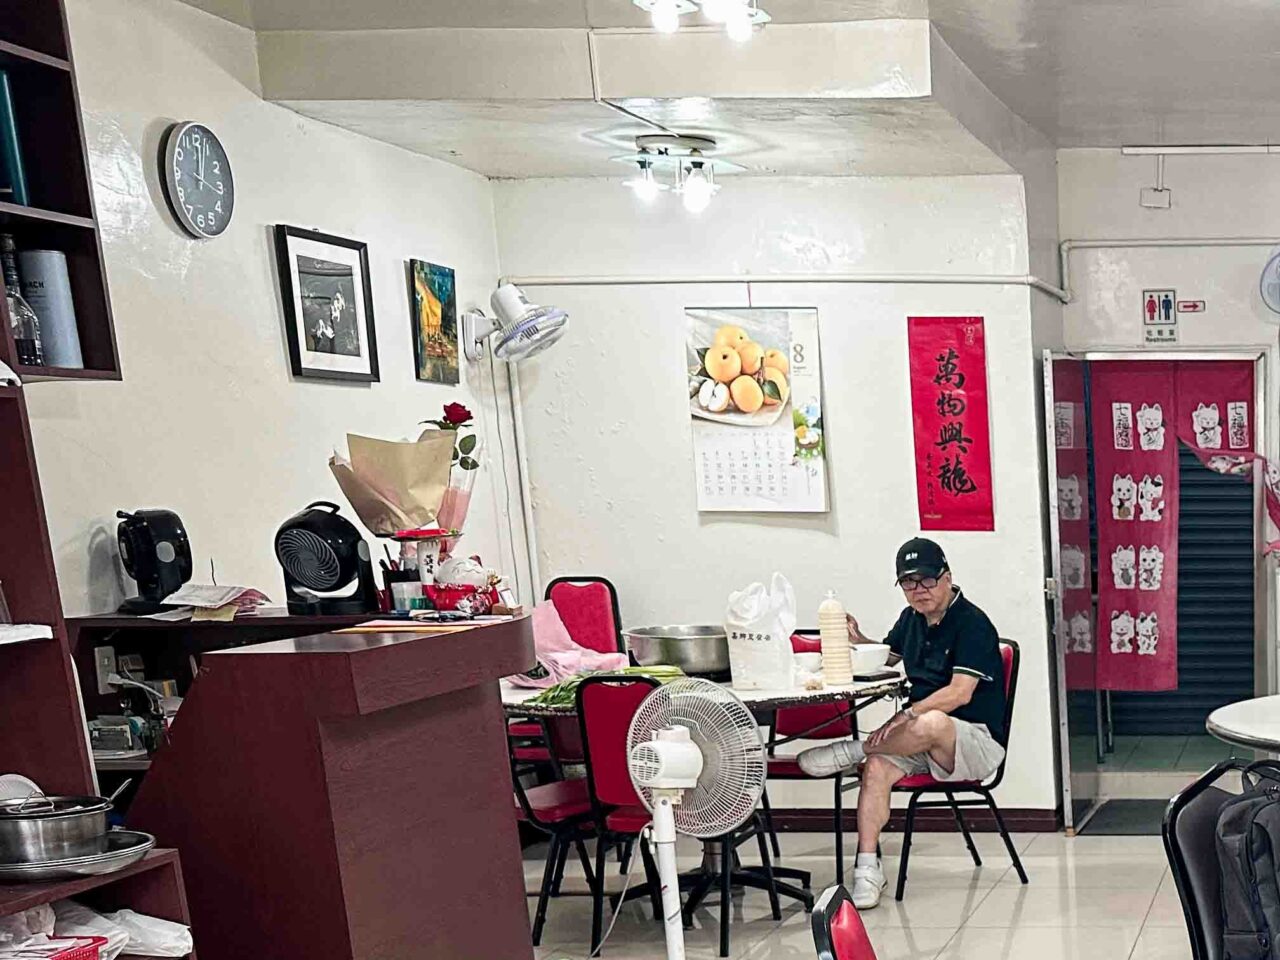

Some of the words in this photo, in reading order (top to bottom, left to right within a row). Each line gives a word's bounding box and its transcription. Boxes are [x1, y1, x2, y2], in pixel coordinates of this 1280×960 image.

[182, 135, 190, 149] 11
[212, 161, 220, 174] 2
[216, 182, 224, 195] 3
[186, 204, 193, 218] 7
[215, 201, 222, 213] 4
[197, 215, 205, 228] 6
[207, 212, 215, 225] 5
[793, 343, 805, 363] 8
